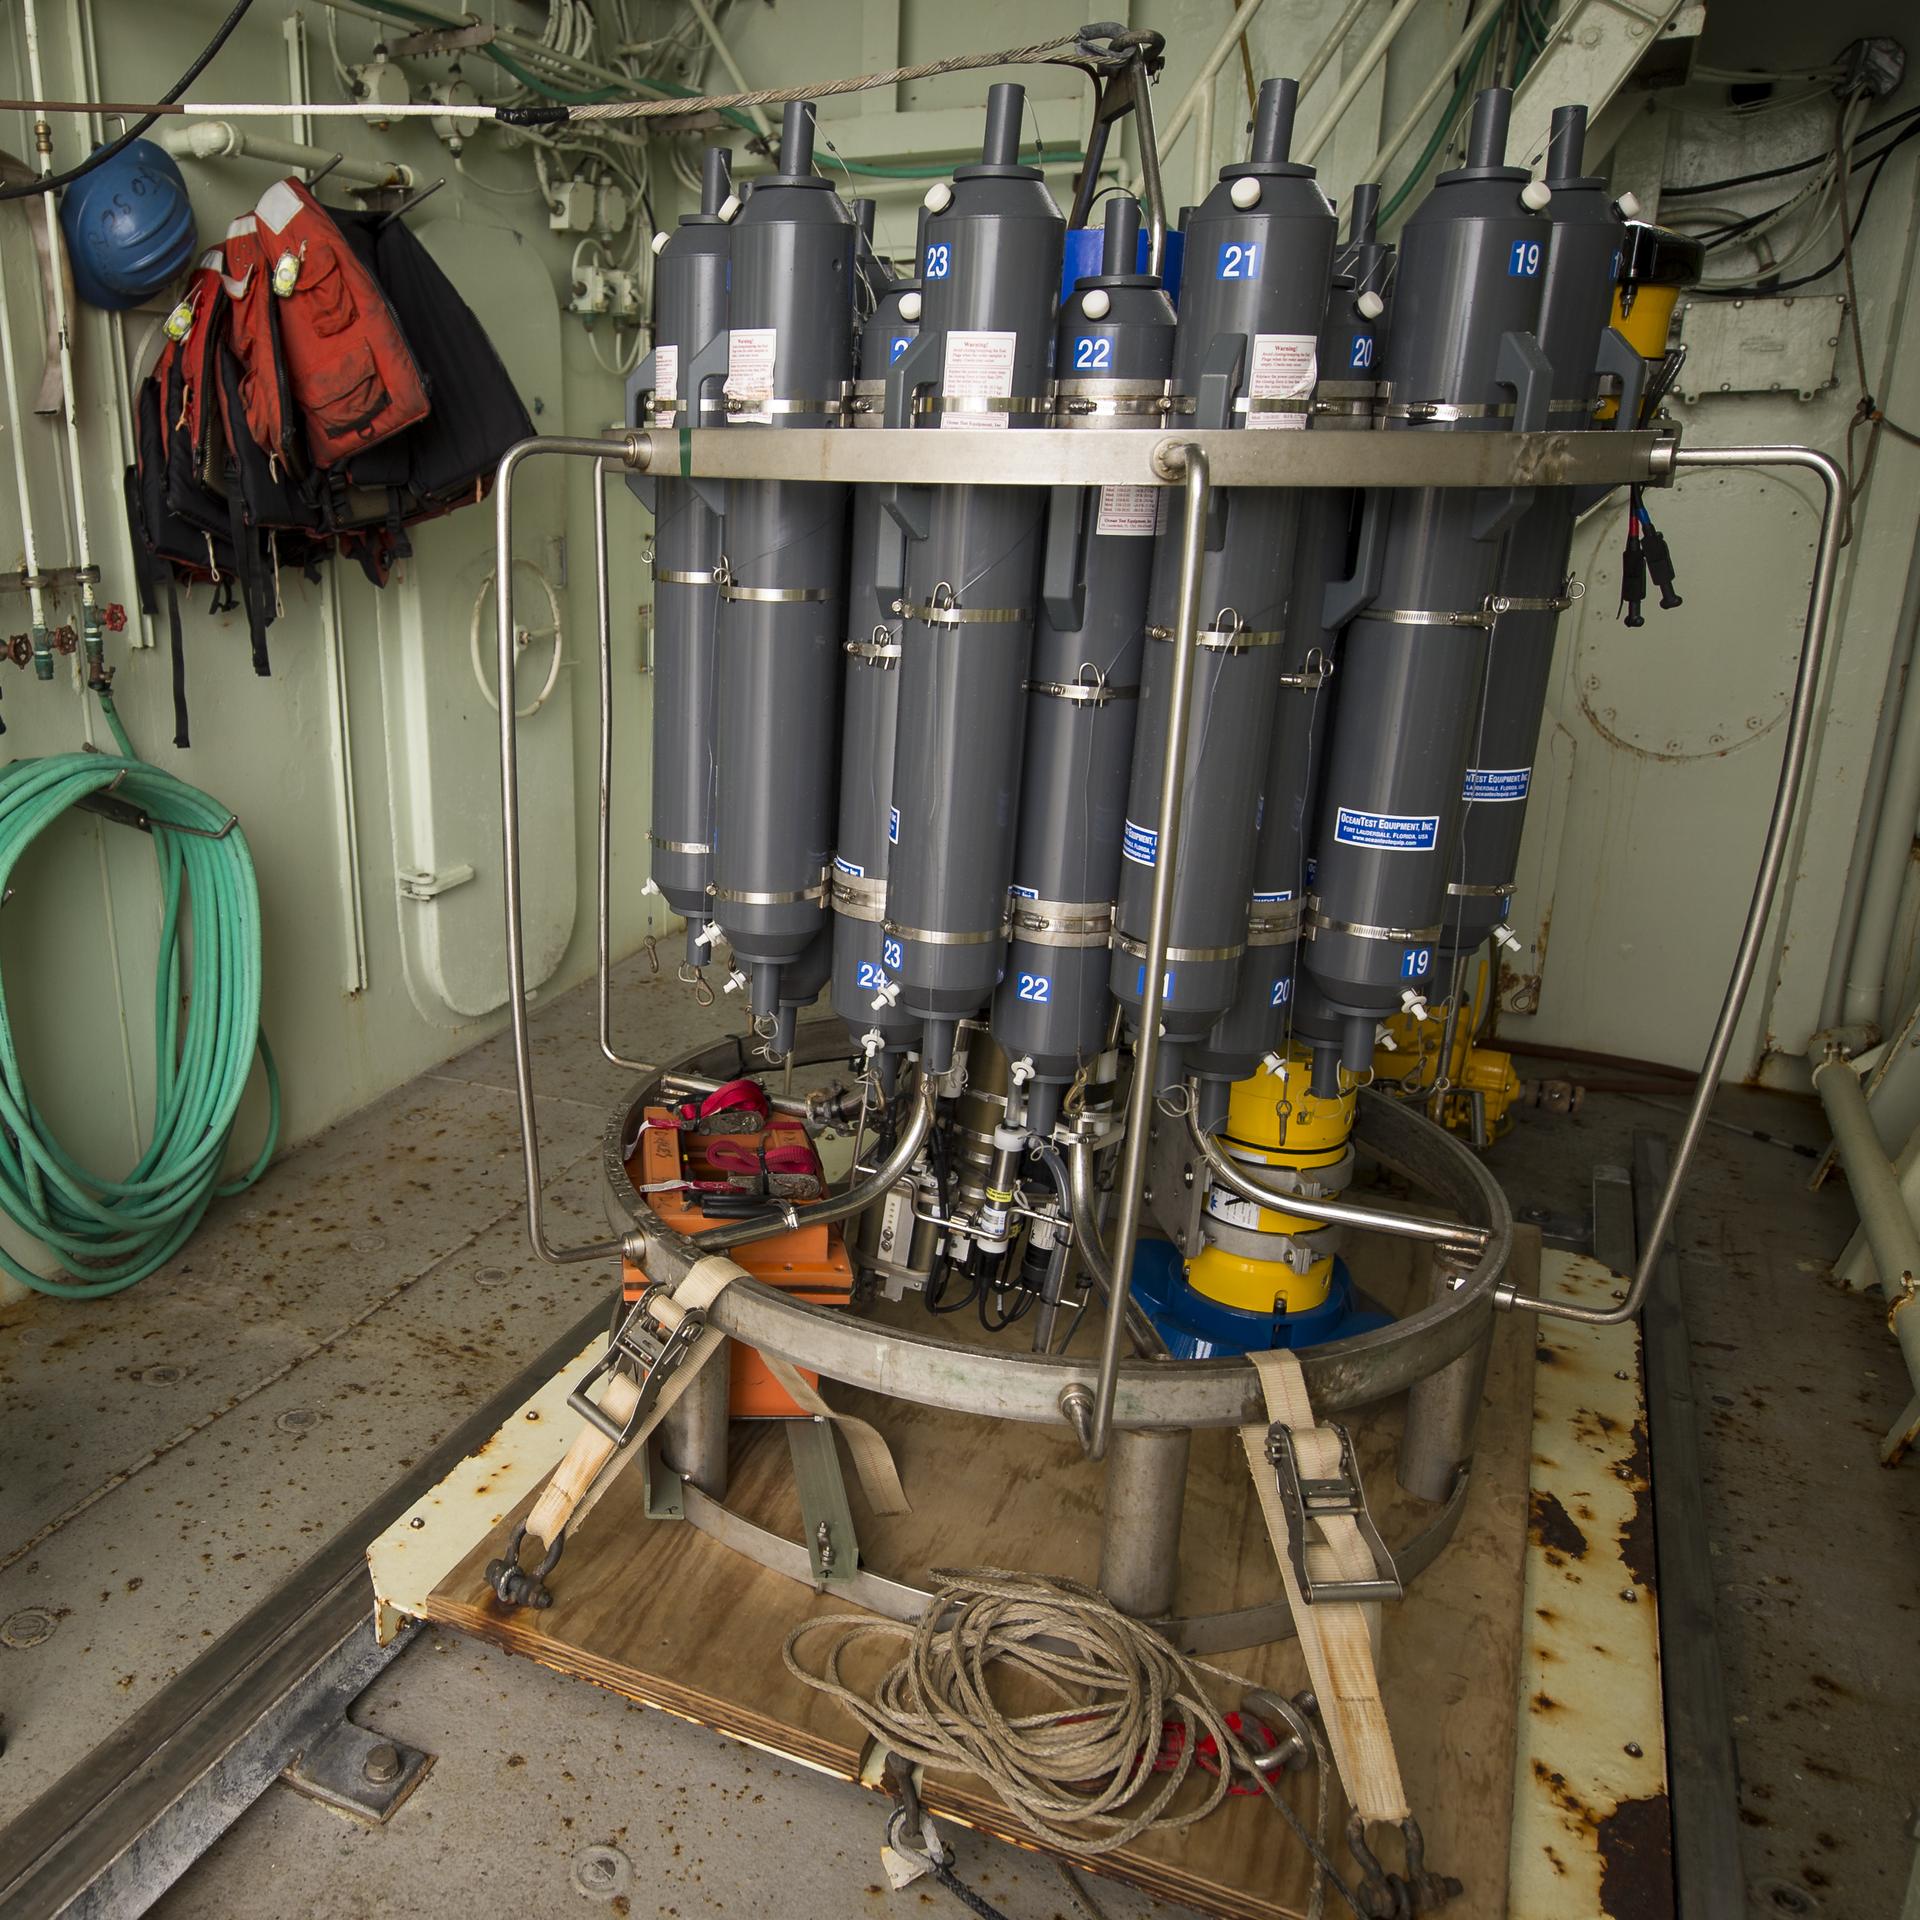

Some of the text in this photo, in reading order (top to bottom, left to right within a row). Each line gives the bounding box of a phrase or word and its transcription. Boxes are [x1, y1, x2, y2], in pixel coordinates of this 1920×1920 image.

[927, 245, 948, 278] 23
[1222, 244, 1257, 278] 21
[1516, 243, 1539, 275] 19
[894, 339, 909, 362] 2
[1076, 338, 1110, 368] 22
[1353, 338, 1373, 367] 20
[884, 939, 901, 969] 23
[1406, 949, 1429, 976] 19
[860, 964, 889, 988] 24
[1019, 975, 1049, 1002] 22
[1273, 978, 1291, 1005] 20
